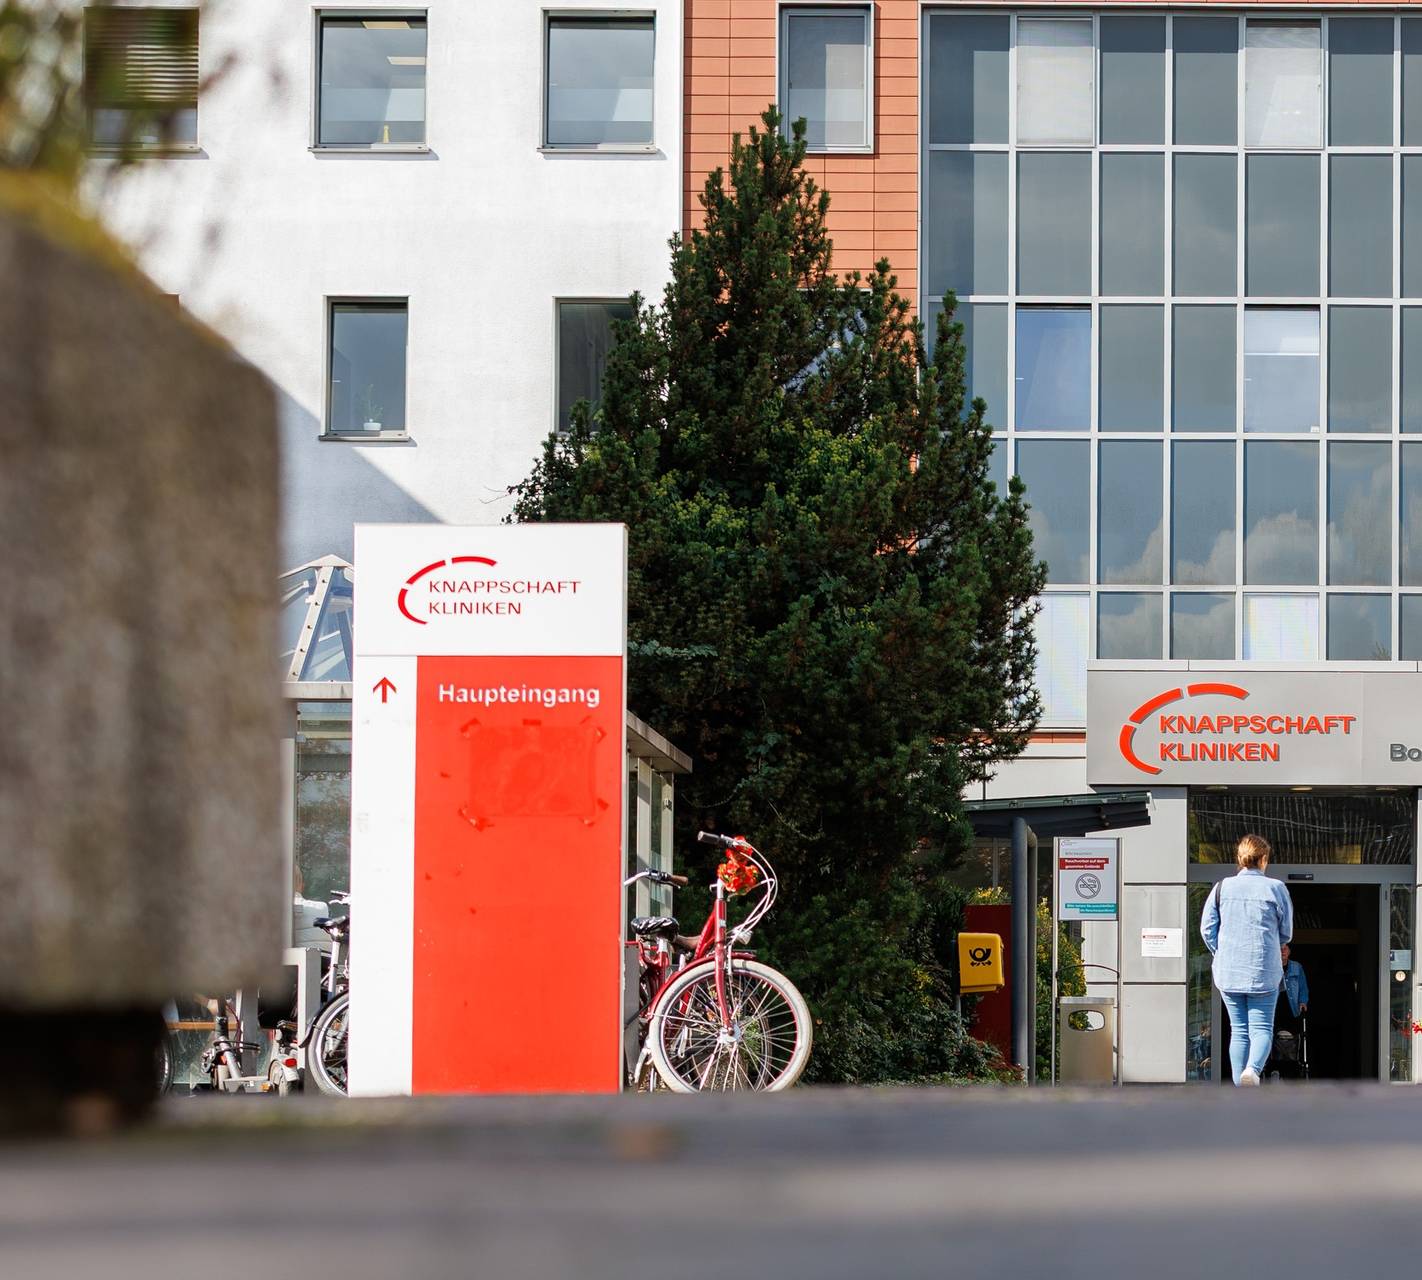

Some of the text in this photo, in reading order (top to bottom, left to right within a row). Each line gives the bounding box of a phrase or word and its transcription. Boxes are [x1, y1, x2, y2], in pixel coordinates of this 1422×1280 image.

[429, 581, 582, 594] KNAPPSCHAFT
[429, 602, 522, 615] KLINIKEN
[438, 684, 600, 708] Haupteingang
[1159, 715, 1356, 735] KNAPPSCHAFT
[1159, 742, 1280, 762] KLINIKEN
